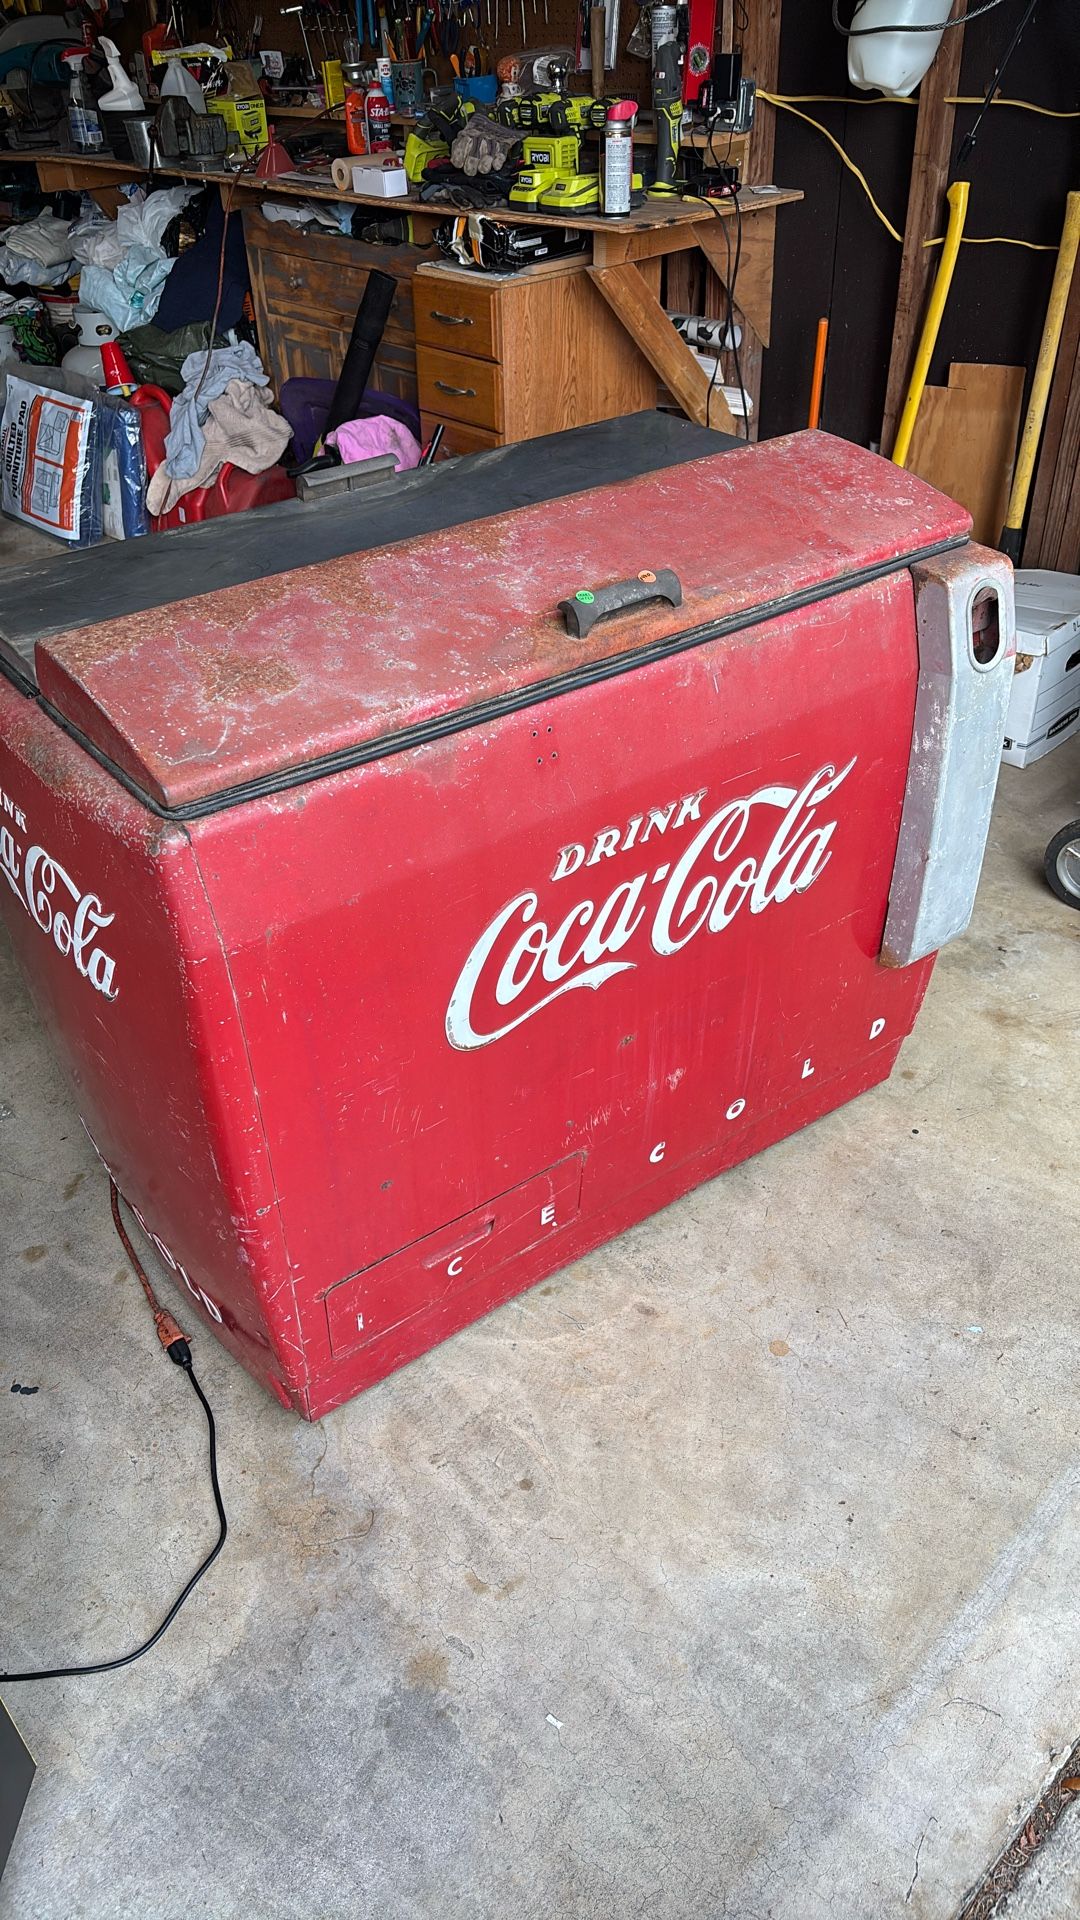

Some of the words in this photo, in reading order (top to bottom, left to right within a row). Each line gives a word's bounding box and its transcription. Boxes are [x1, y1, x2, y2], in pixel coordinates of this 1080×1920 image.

[532, 152, 549, 162] RYOBI
[6, 422, 17, 473] QUILTED
[12, 428, 25, 500] FURNITURE
[19, 400, 27, 424] PAD
[550, 787, 709, 883] DRINK
[444, 754, 859, 1053] Coca-Cola
[357, 1203, 557, 1332] ICE
[649, 1017, 886, 1163] COLD
